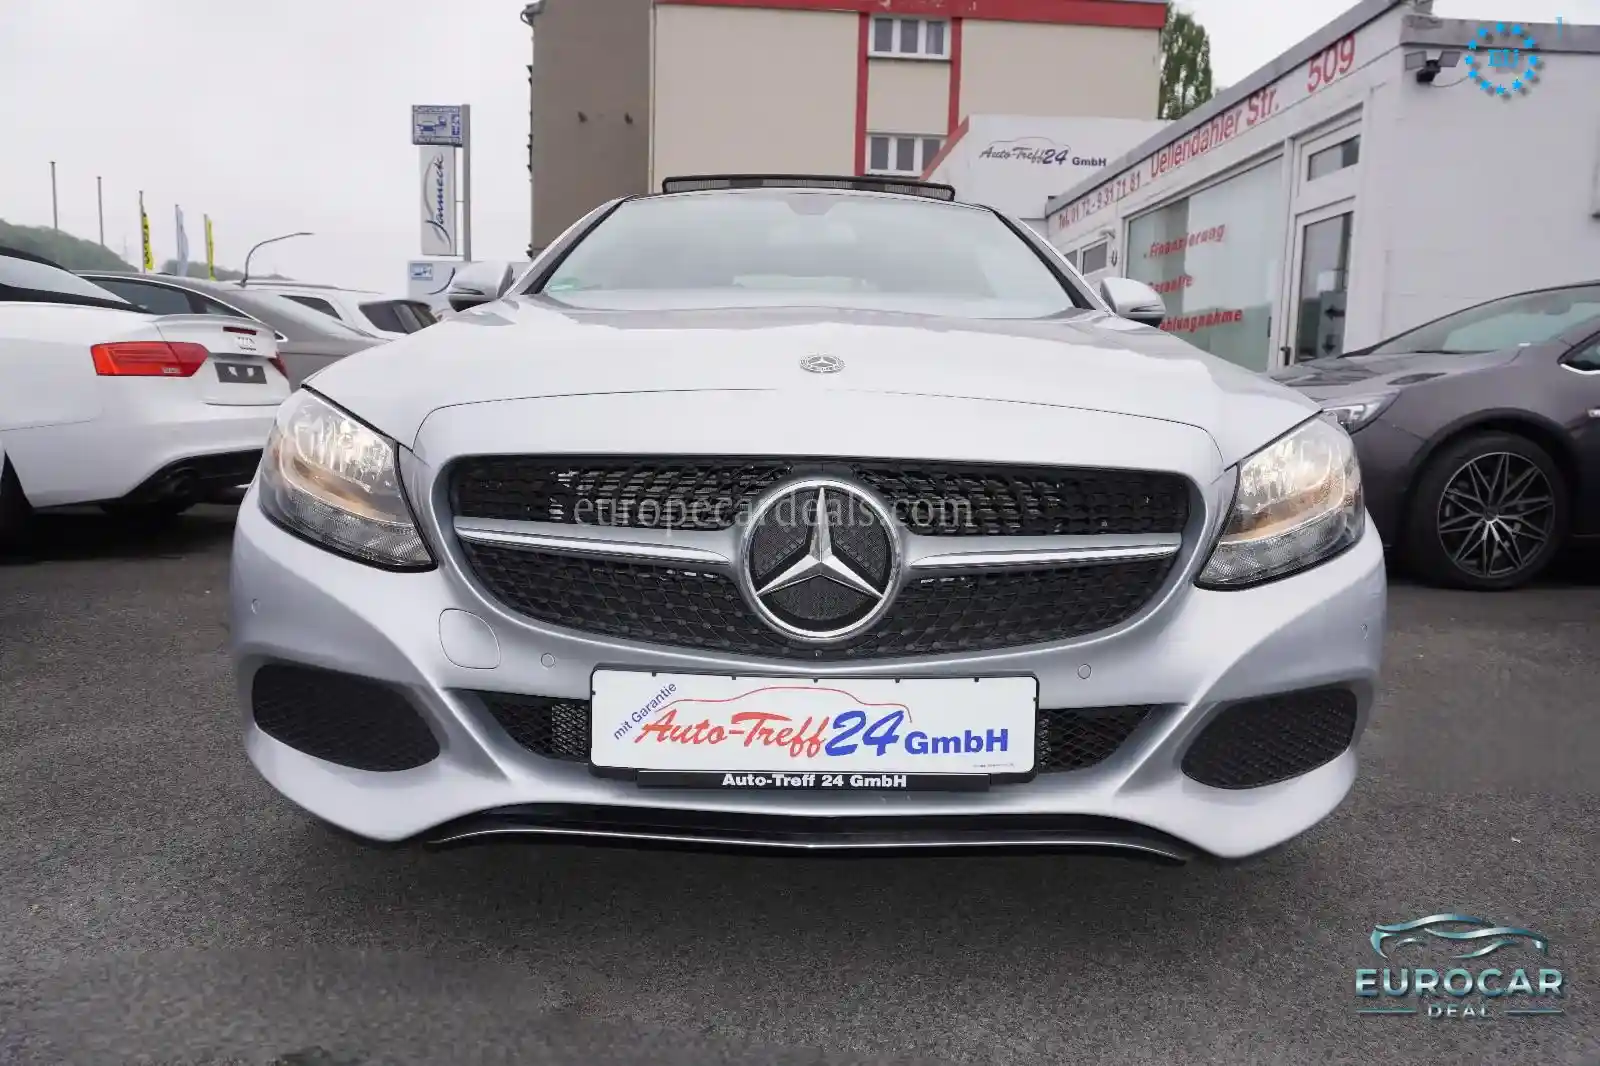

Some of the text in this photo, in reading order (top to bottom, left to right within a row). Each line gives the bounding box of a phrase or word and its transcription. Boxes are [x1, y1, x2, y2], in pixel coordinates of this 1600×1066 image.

[1246, 87, 1281, 126] Str.
[1307, 33, 1356, 93] 509
[1072, 157, 1107, 167] GmbH
[614, 682, 678, 741] mit Garantie
[904, 728, 1009, 754] GmbH
[722, 773, 907, 788] Auto-Treff 24 GmbH
